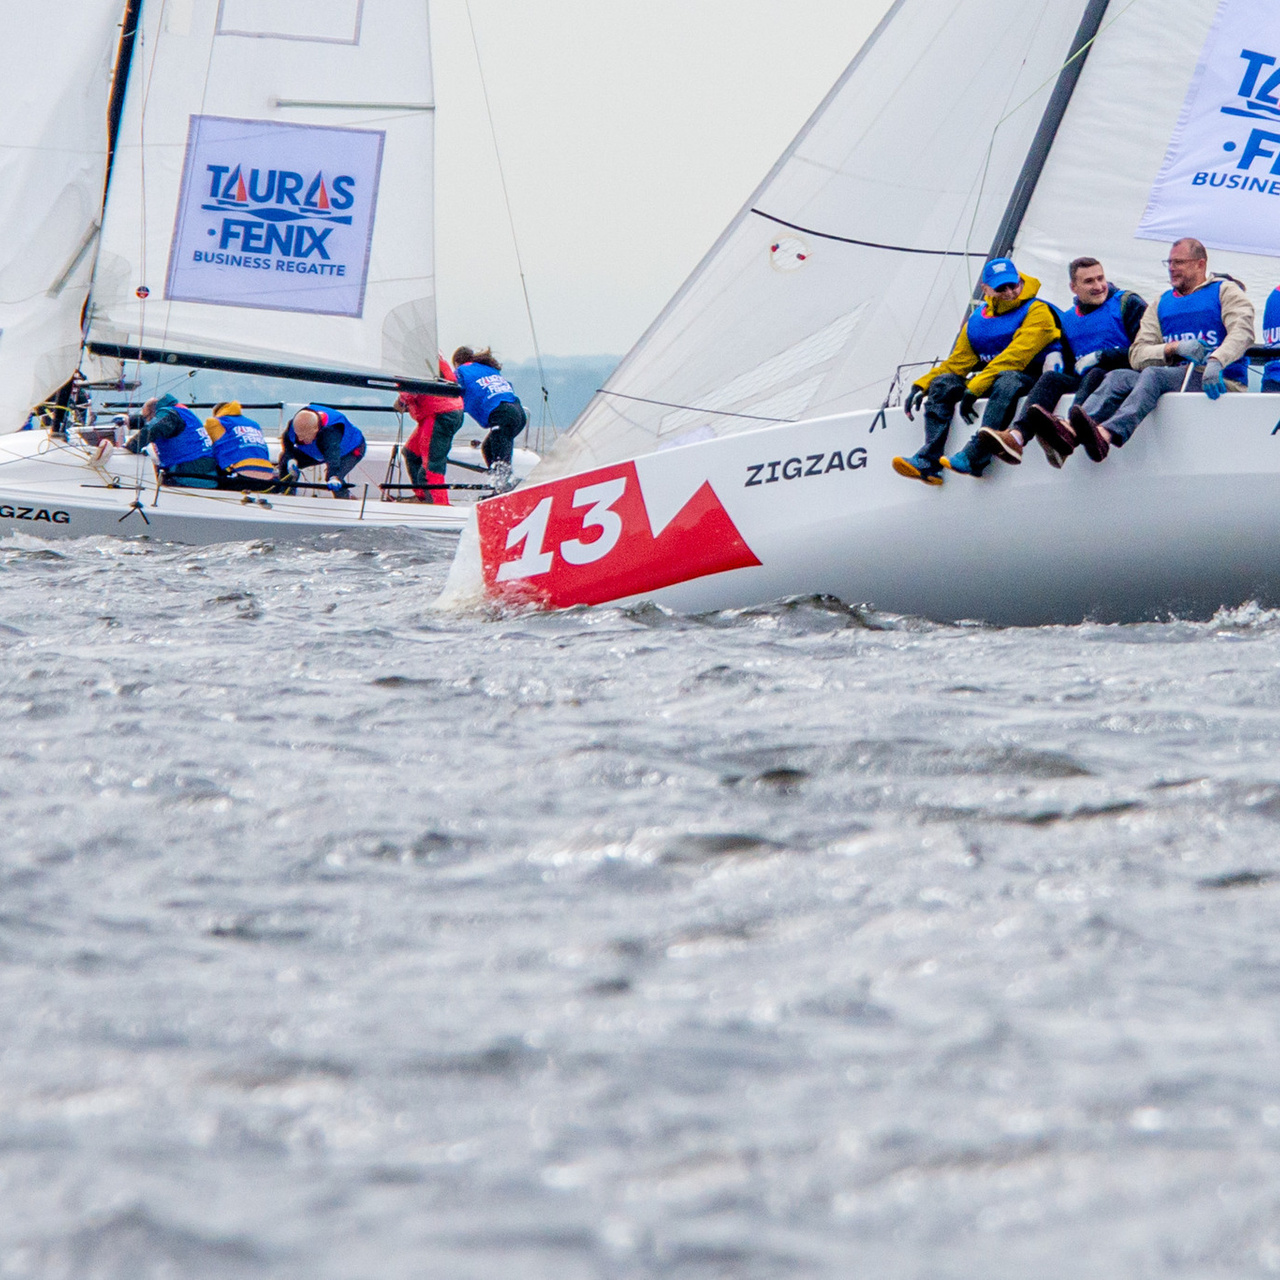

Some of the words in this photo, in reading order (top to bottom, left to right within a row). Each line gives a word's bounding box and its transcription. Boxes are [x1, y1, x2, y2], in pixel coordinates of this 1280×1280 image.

[206, 163, 354, 210] TAURAS
[194, 251, 272, 270] BUSINESS
[274, 258, 346, 276] REGATTE
[745, 447, 868, 488] ZIGZAG
[496, 477, 627, 582] 13
